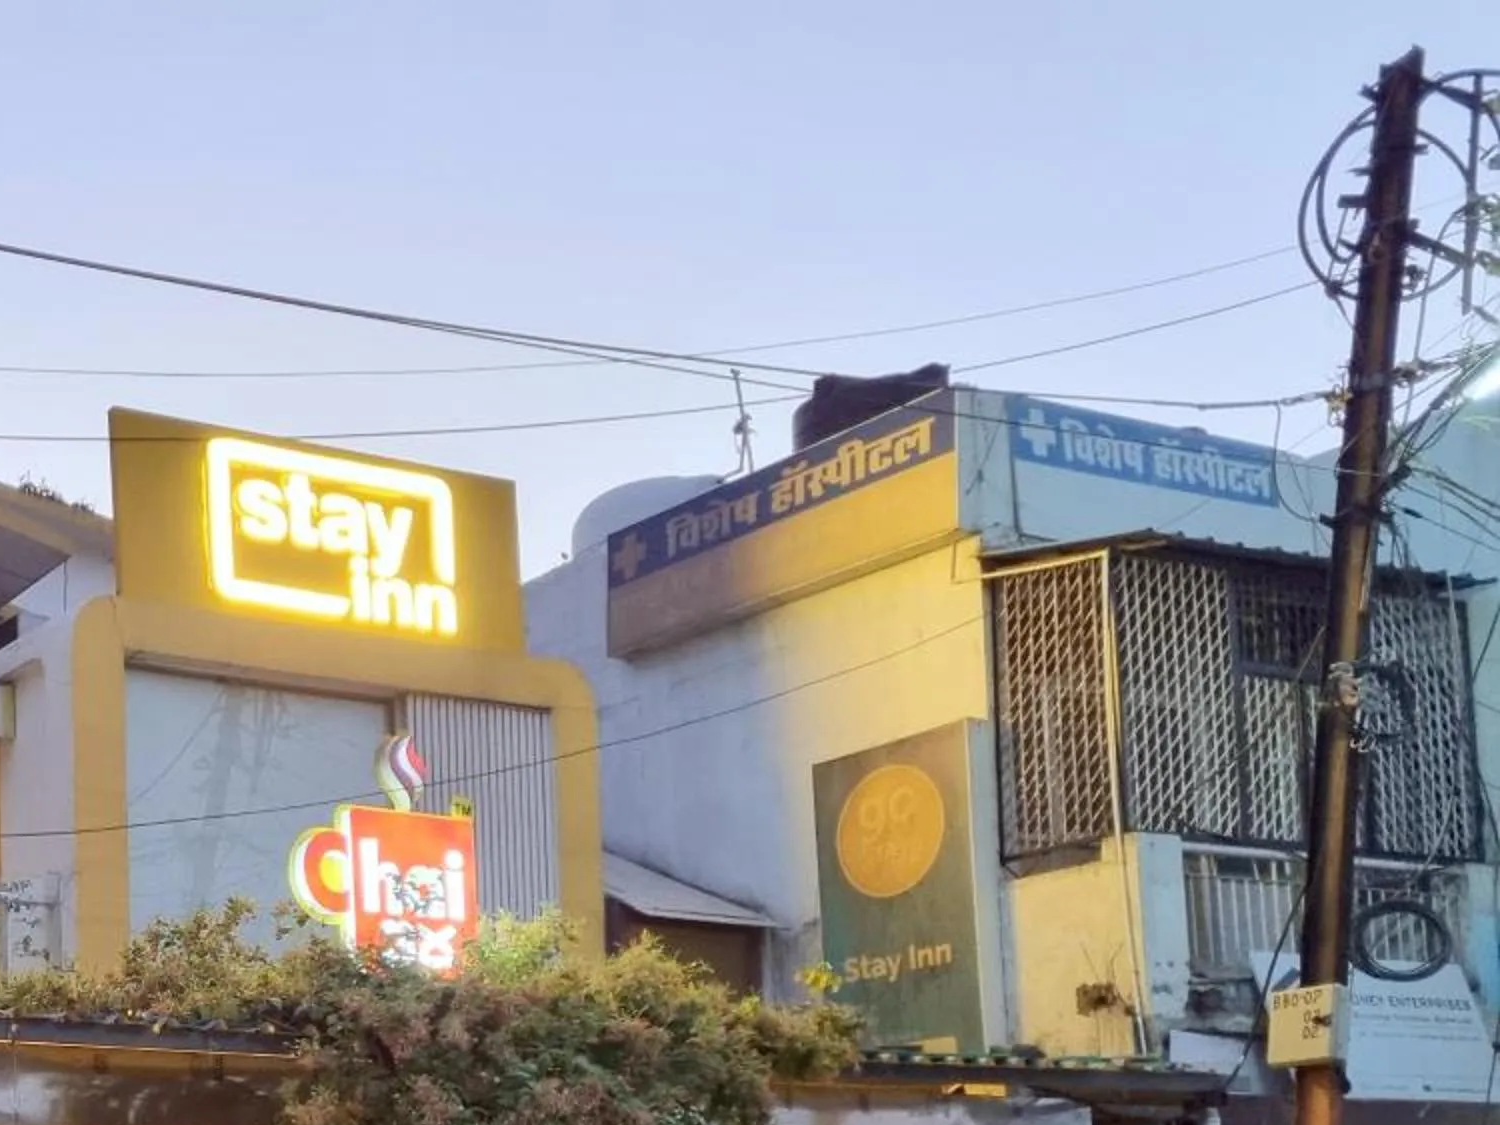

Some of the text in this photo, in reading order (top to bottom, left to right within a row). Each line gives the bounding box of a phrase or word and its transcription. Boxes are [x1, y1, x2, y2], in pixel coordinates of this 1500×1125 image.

[1059, 417, 1145, 476] विशेष
[236, 472, 414, 577] stay
[665, 489, 760, 558] विशेष
[348, 556, 459, 638] inn
[843, 943, 952, 983] Stay Inn
